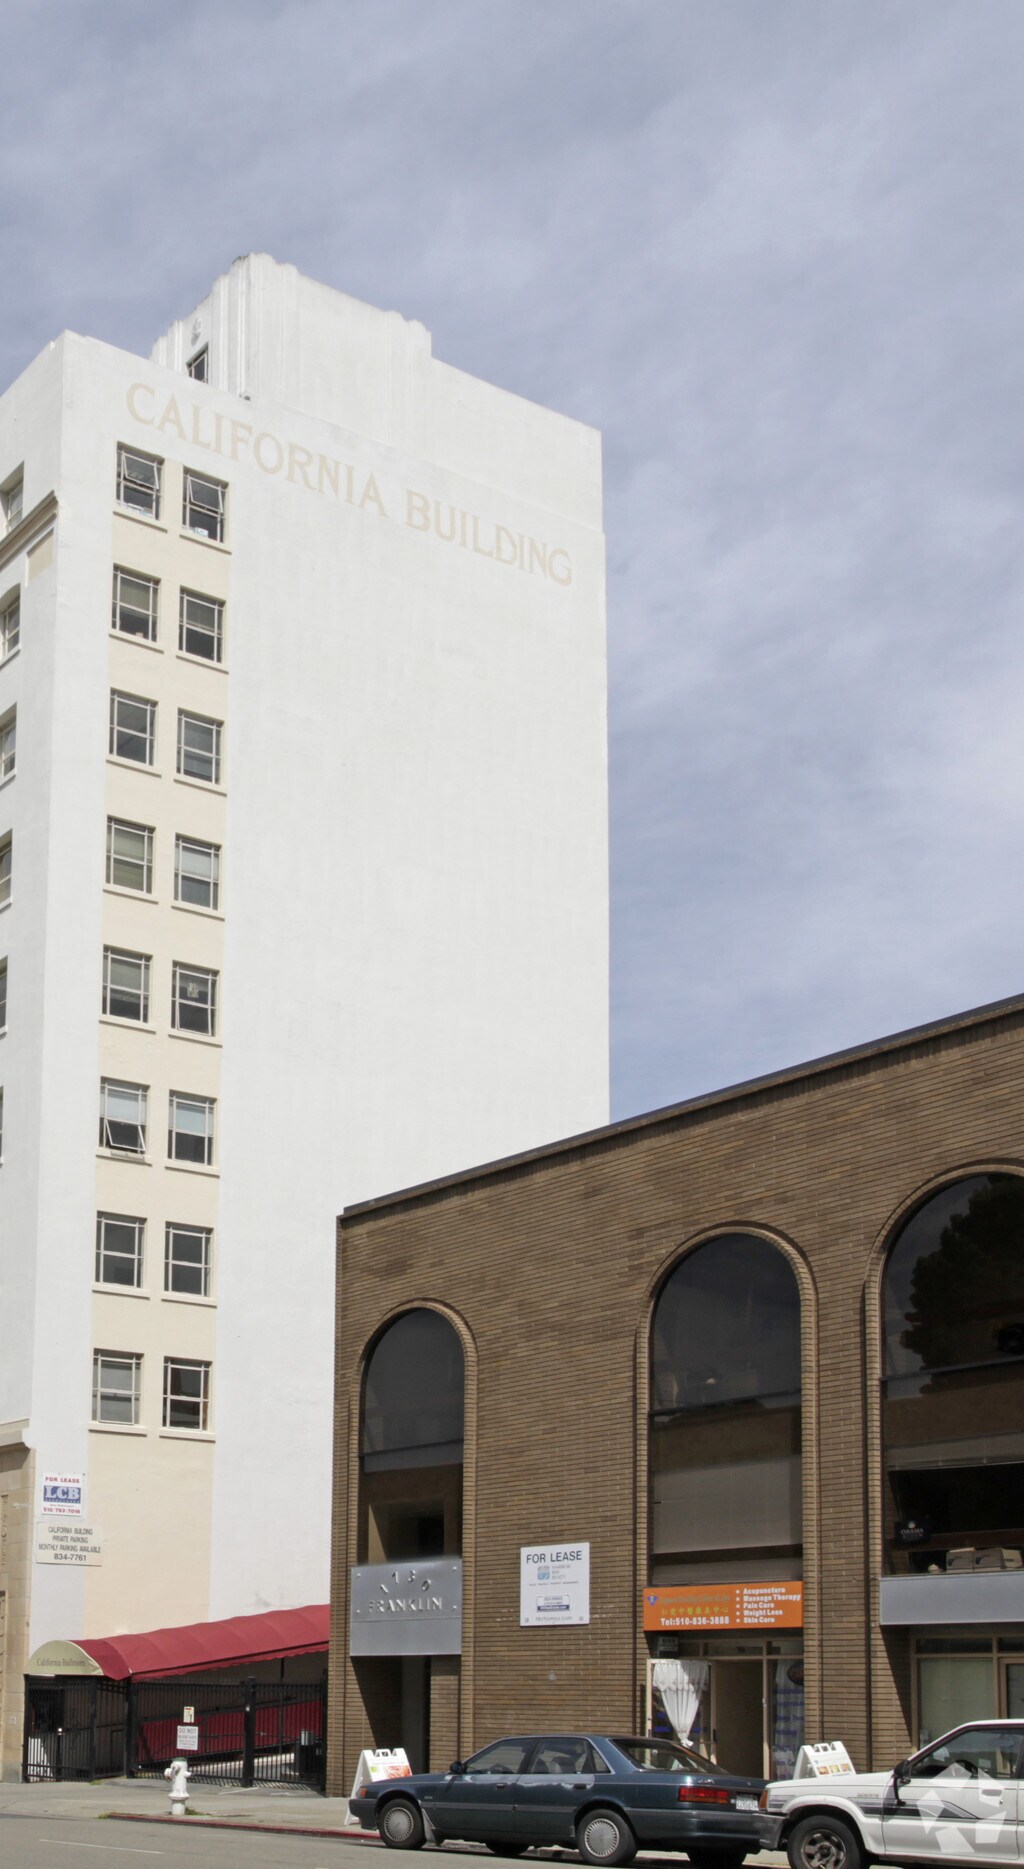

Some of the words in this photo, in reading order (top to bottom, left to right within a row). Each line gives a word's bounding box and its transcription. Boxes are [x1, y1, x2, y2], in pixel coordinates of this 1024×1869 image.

[126, 382, 388, 518] CALIFORNIA
[405, 488, 573, 586] BUILDING
[45, 1486, 80, 1500] LCB
[48, 1526, 72, 1534] CALIFORNIA
[74, 1527, 93, 1536] BUILDING
[52, 1535, 69, 1543] PRIVATE
[70, 1536, 88, 1544] PARKING
[39, 1543, 58, 1551] MONTHLY
[60, 1544, 78, 1552] PARKING
[79, 1545, 102, 1554] AVAILABLE
[53, 1553, 87, 1562] 834-7761
[526, 1553, 546, 1564] FOR
[550, 1550, 583, 1563] LEASE
[743, 1587, 785, 1596] Acupuncture
[368, 1596, 443, 1612] FRANKLIN
[743, 1609, 766, 1617] Weight
[37, 1657, 61, 1667] California
